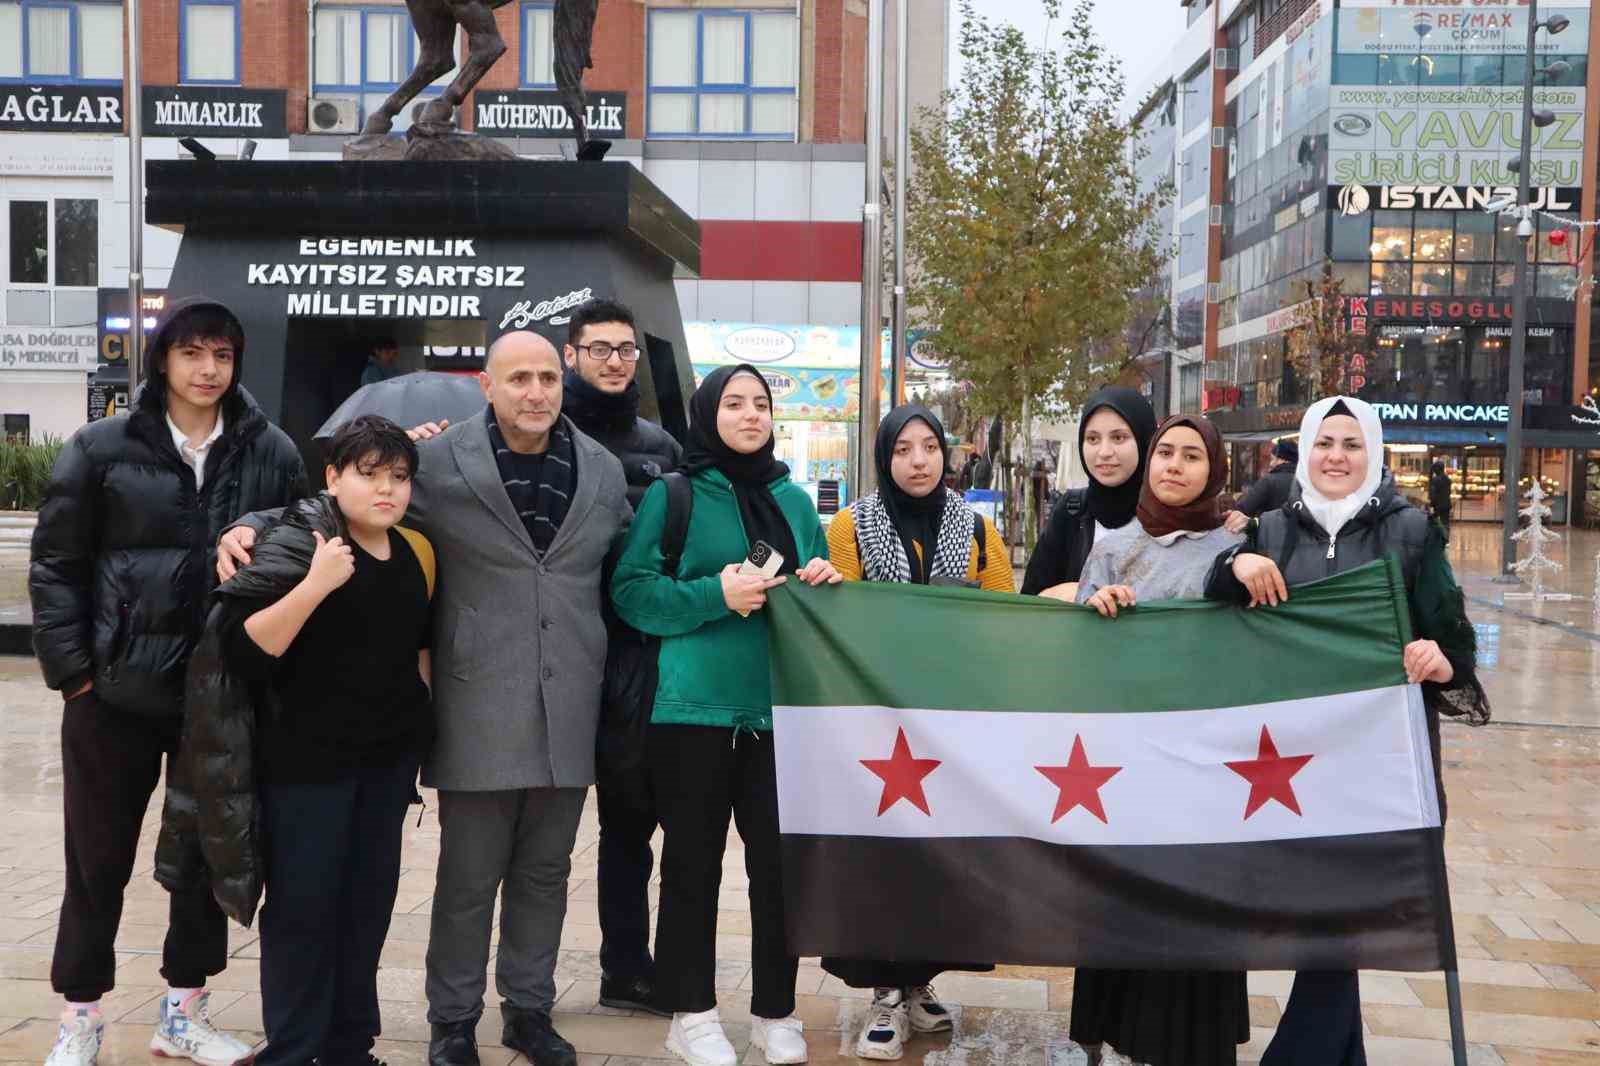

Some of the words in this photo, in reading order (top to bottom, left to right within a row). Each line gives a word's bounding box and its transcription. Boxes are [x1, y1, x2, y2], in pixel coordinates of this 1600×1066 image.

[1438, 12, 1512, 28] RE/MAX
[155, 94, 263, 128] MİMARLIK
[477, 95, 623, 131] MÜHENDLİK
[1378, 111, 1584, 149] YAVUZ
[1335, 152, 1461, 185] SÜRÜCÜ
[1470, 159, 1577, 185] KUSU
[248, 264, 387, 285] KAYITSIZ
[396, 265, 525, 288] ŞARTSIZ
[1425, 404, 1510, 421] PANCAKE
